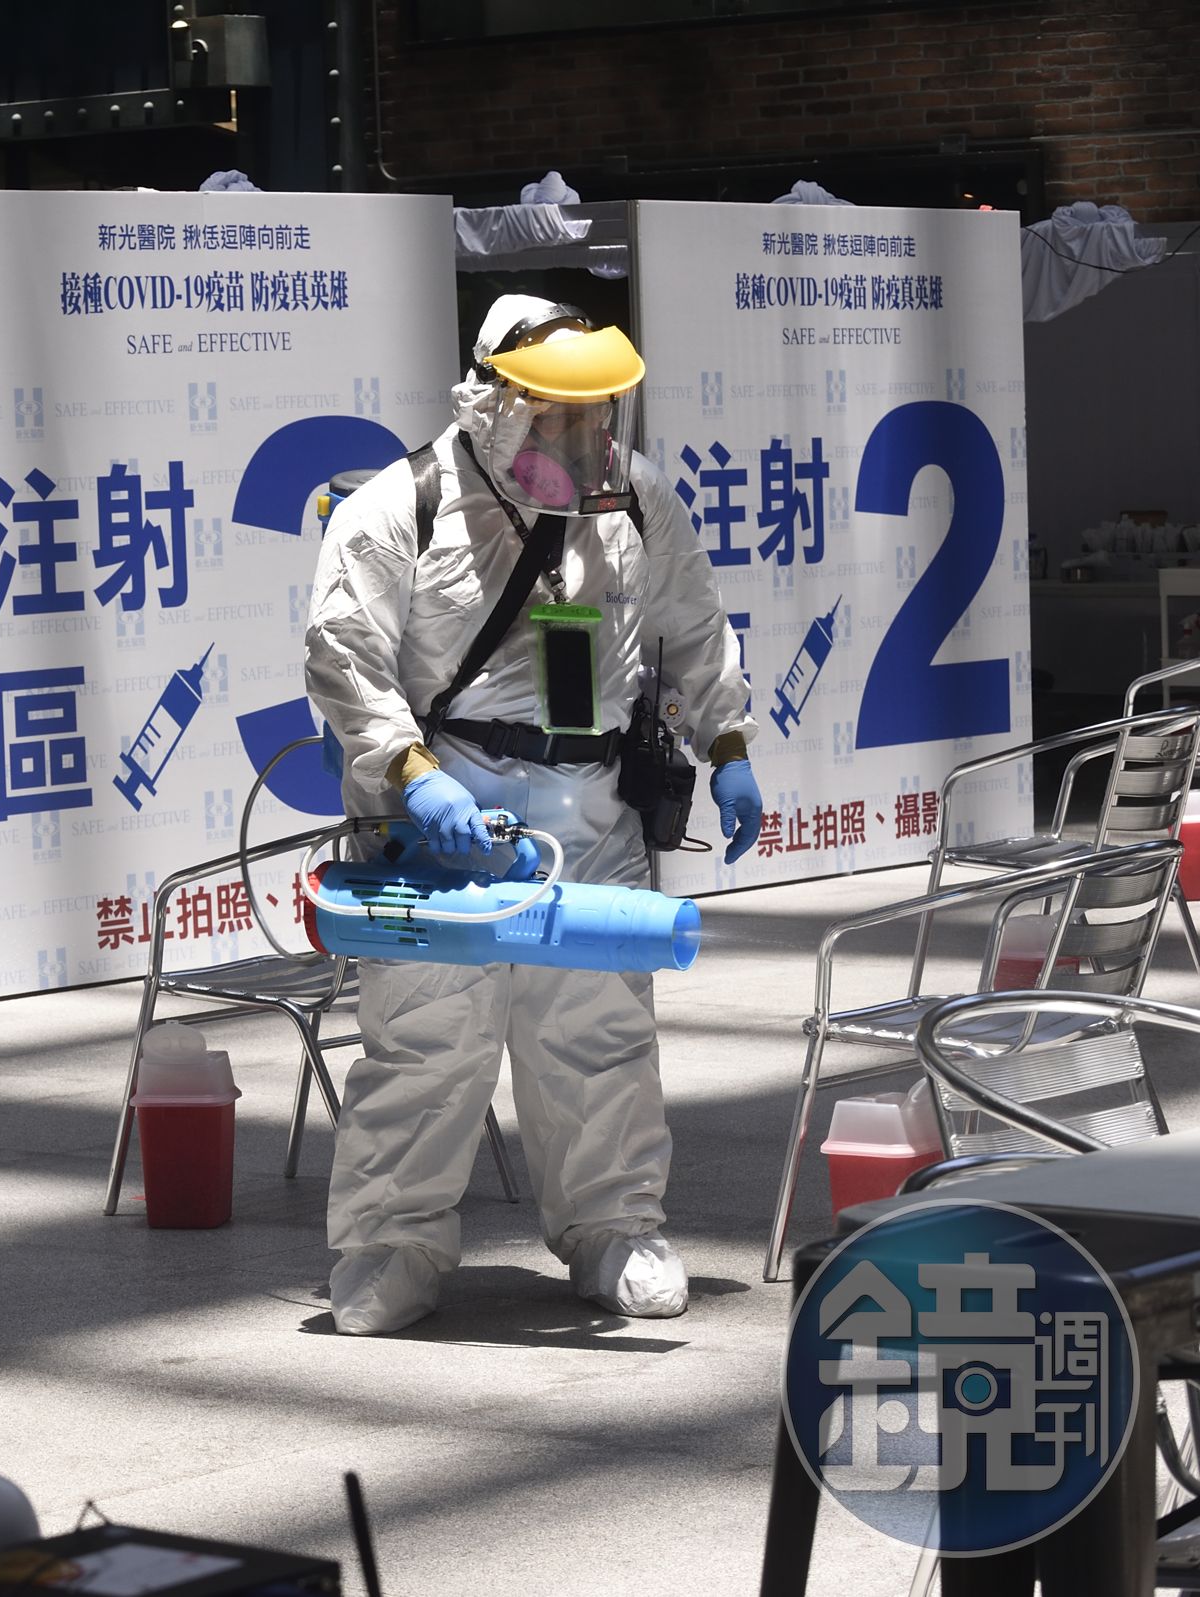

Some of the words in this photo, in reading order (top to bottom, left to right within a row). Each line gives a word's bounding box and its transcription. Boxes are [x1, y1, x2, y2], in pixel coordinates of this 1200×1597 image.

[97, 223, 176, 251] 新光醫院
[182, 223, 311, 251] 揪恁逗陣向前走
[762, 232, 818, 256] 新光醫院
[823, 233, 917, 258] 揪恁逗陣向前走
[59, 270, 244, 315] 接種COVID-19疫苗
[250, 269, 350, 313] 防疫真英雄
[735, 273, 867, 311] 接種COVID-19疫苗
[871, 274, 944, 311] 防疫真英雄
[126, 333, 173, 355] SAFE
[178, 342, 193, 353] and
[197, 331, 293, 353] EFFECTIVE
[782, 328, 816, 345] SAFE
[833, 327, 901, 345] EFFECTIVE
[55, 401, 88, 417] SAFE
[104, 399, 175, 416] EFFECTIVE
[229, 396, 261, 412] SAFE
[275, 393, 342, 410] EFFECTIVE
[674, 436, 830, 568] 注射
[854, 400, 1013, 750] 2
[32, 616, 102, 635] EFFECTIVE
[158, 610, 191, 625] SAFE
[208, 602, 274, 622] EFFECTIVE
[240, 665, 271, 682] SAFE
[71, 819, 104, 837] SAFE
[121, 809, 191, 832] EFFECTIVE
[96, 872, 308, 951] 禁止拍照、
